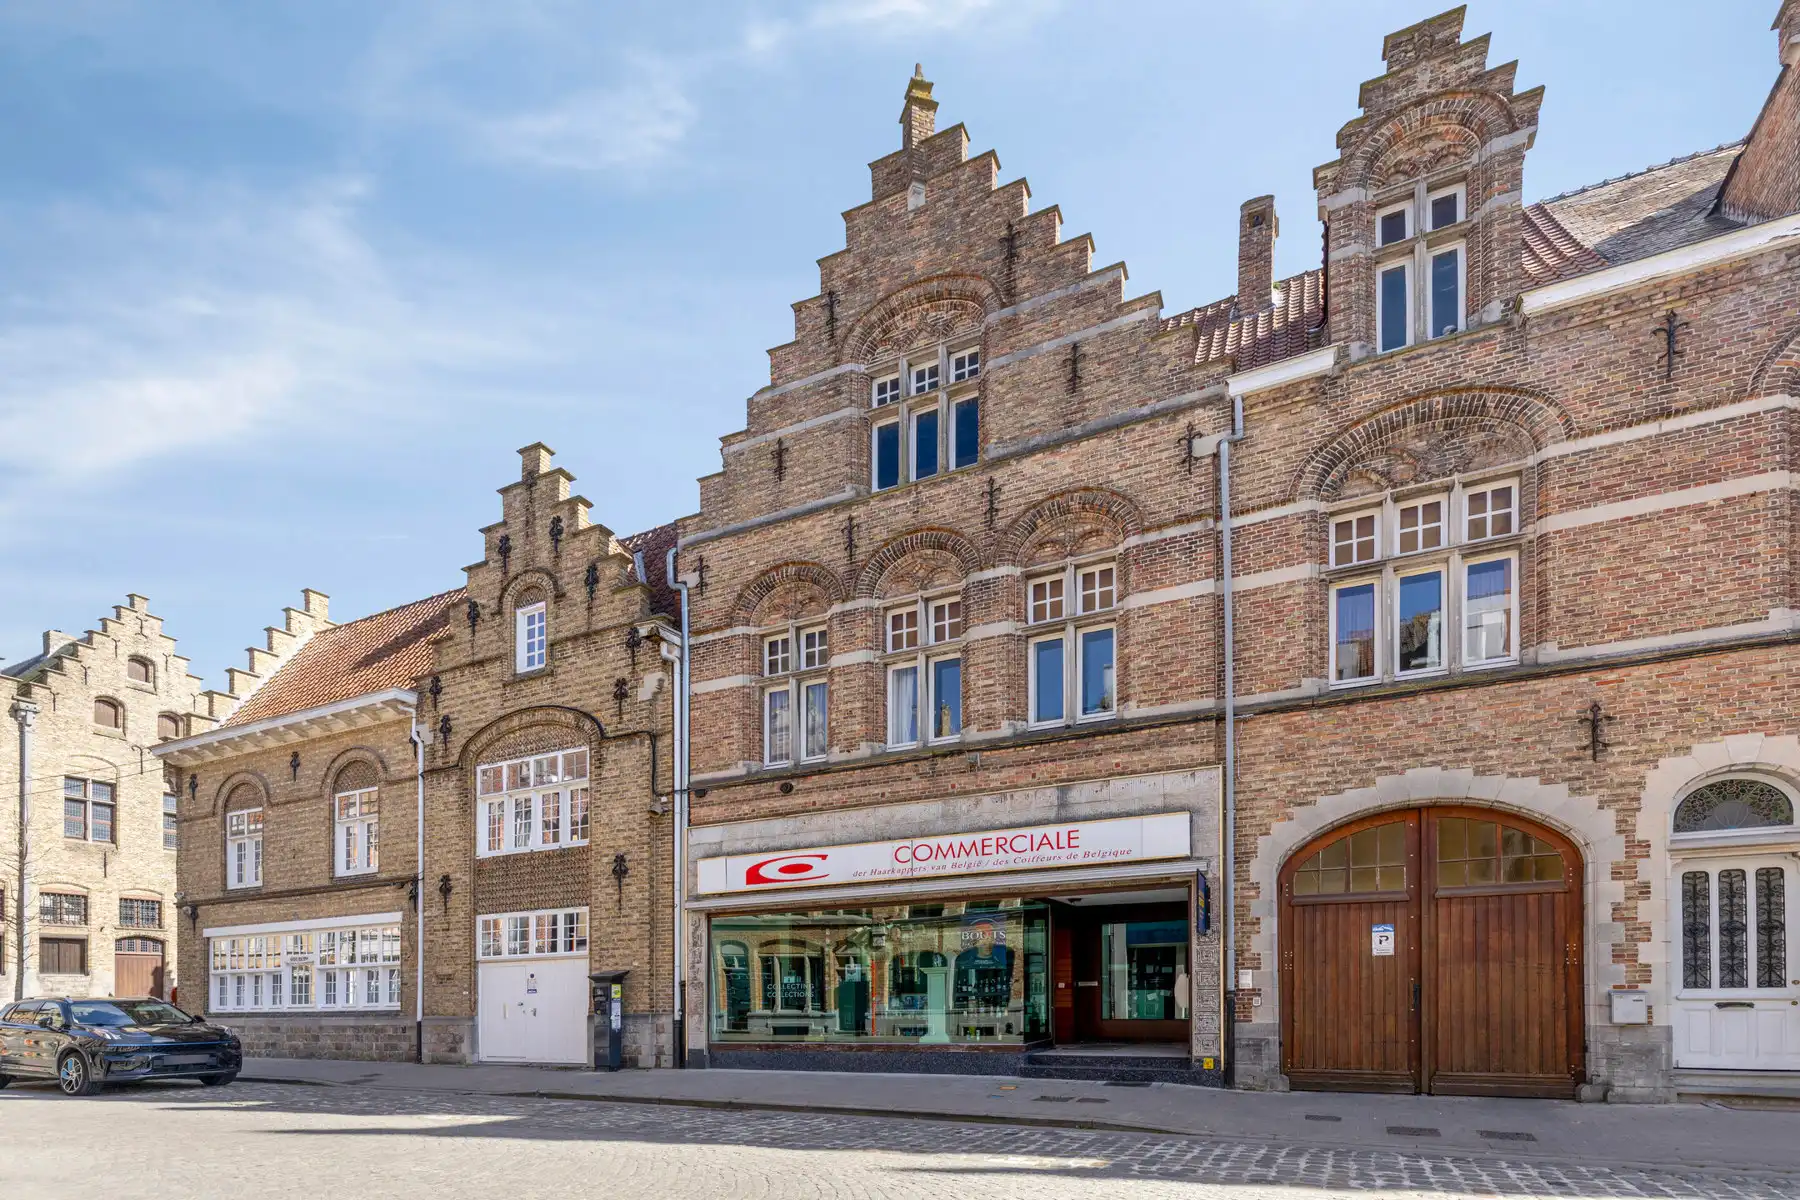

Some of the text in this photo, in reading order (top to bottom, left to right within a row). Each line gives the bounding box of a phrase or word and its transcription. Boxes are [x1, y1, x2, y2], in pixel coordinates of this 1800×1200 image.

[852, 868, 867, 877] der
[870, 866, 927, 877] Haarkappers
[951, 861, 982, 870] België
[993, 858, 1009, 866] des
[1013, 854, 1062, 864] Coiffeurs
[1066, 851, 1079, 860] de
[1083, 848, 1132, 859] Belgique
[894, 829, 1080, 864] COMMERCIALE
